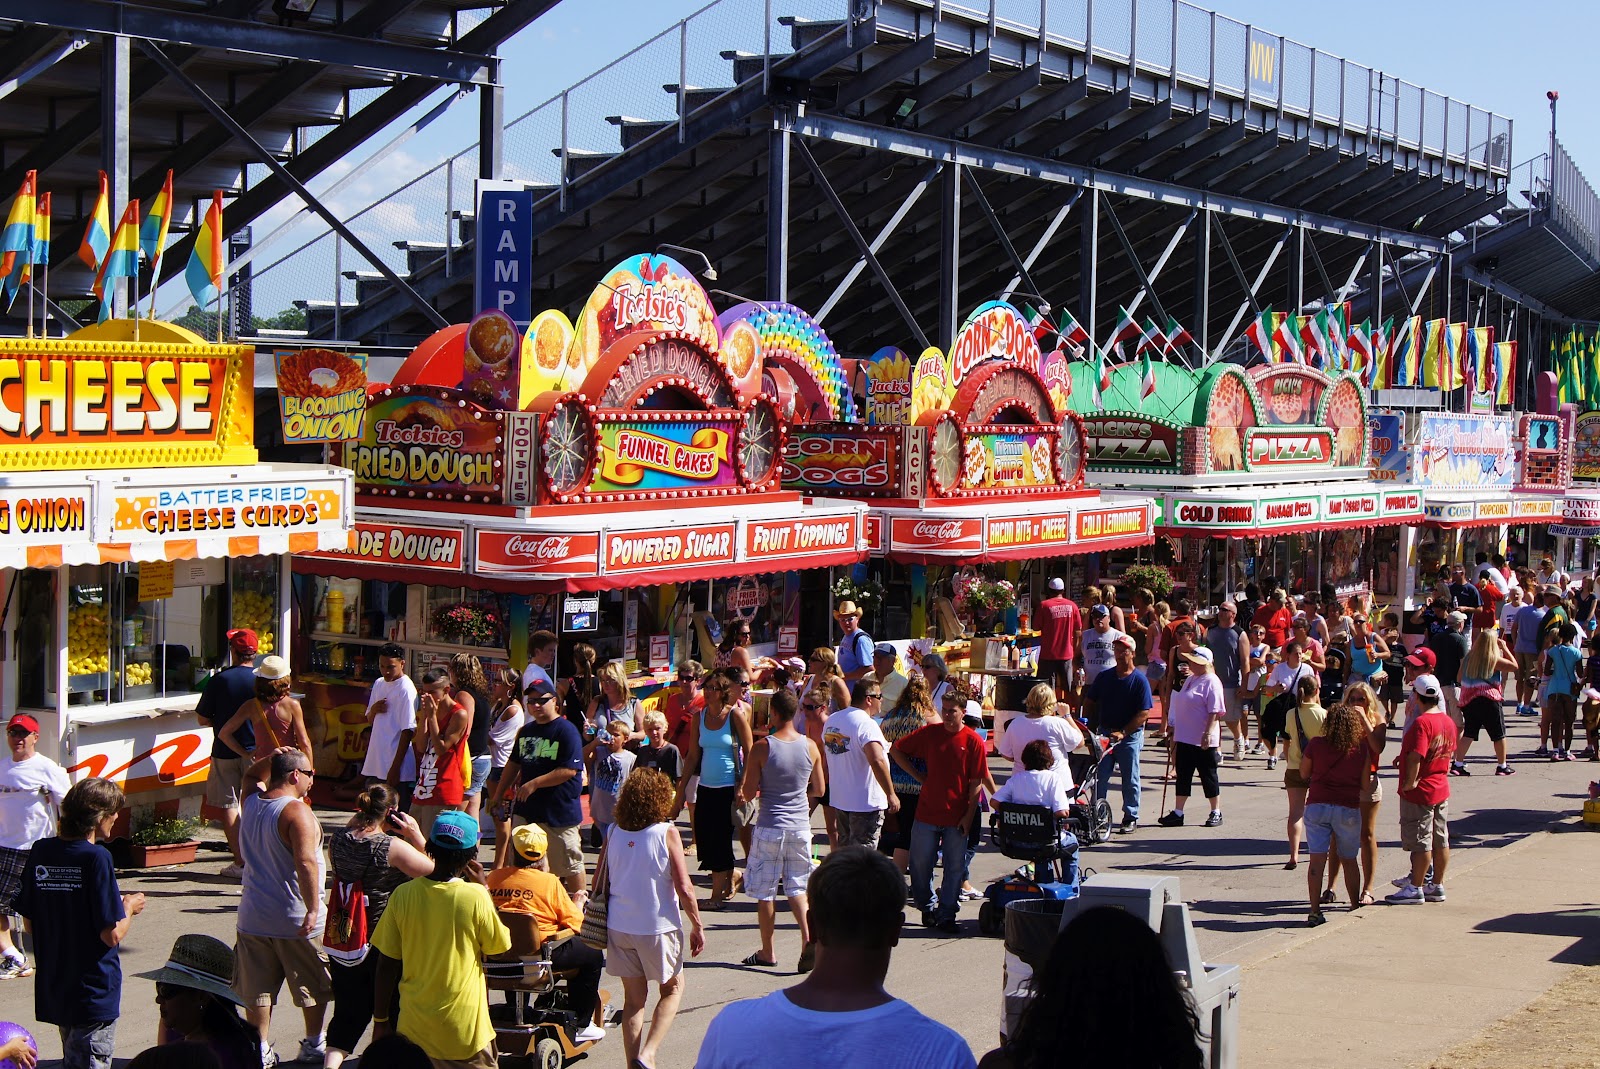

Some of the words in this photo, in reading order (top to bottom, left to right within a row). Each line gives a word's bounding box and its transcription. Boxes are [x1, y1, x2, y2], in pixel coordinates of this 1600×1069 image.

[494, 199, 519, 312] RAMP
[614, 284, 688, 330] Tootsie's
[952, 317, 992, 387] CORN
[1005, 310, 1041, 372] DOGS
[667, 341, 720, 399] DOUGH
[915, 355, 948, 389] Jack's
[1045, 357, 1071, 390] Jack's
[0, 358, 212, 437] CHEESE
[867, 377, 911, 395] Jack's
[284, 387, 366, 416] BLOOMING
[865, 400, 912, 426] FRIES
[285, 411, 365, 441] ONION
[375, 420, 463, 447] Tootsies
[1087, 421, 1152, 438] RICK'S
[1452, 422, 1482, 456] Sweet
[514, 417, 529, 501] TOOTSIE'S
[618, 432, 670, 466] FUNNEL
[674, 446, 715, 474] CAKES
[785, 439, 887, 464] CORN
[910, 429, 919, 496] JACK'S
[1038, 441, 1049, 460] HOT
[1087, 438, 1171, 462] IZZA
[1252, 437, 1323, 463] PIZZA
[346, 446, 408, 481] FRIED
[409, 450, 494, 485] DOUGH
[783, 463, 889, 486] DOGS
[968, 454, 985, 479] DOGS
[993, 457, 1024, 481] CHIPS
[159, 490, 243, 506] BATTER
[250, 487, 306, 502] FRIED
[1361, 497, 1374, 512] PIZZA
[1479, 503, 1509, 516] POPCORN
[1521, 503, 1537, 514] COTTON
[16, 497, 84, 533] ONION
[142, 506, 235, 534] CHEESE
[240, 503, 318, 527] CURDS
[1082, 516, 1101, 536] COLD
[1103, 510, 1141, 534] LEMONADE
[1180, 505, 1214, 523] COLD
[1217, 505, 1253, 523] DRINKS
[1266, 503, 1293, 519] SAUSAGE
[1294, 501, 1312, 517] PIZZA
[1448, 505, 1472, 518] CONES
[1562, 509, 1598, 518] CAKES
[753, 525, 792, 553] FRUIT
[794, 521, 848, 549] TOPPINGS
[913, 520, 964, 538] Coca-Cola
[990, 521, 1014, 545] BACON
[1015, 519, 1031, 543] BITS
[1033, 523, 1040, 536] or
[1041, 517, 1066, 540] CHEESE
[1549, 525, 1567, 535] FUNNEL
[1568, 527, 1581, 536] CAKE
[389, 529, 457, 563] DOUGH
[504, 535, 571, 557] Coca-Cola
[610, 535, 682, 565] POWERED
[685, 530, 730, 558] SUGAR
[565, 601, 581, 613] DEEP
[581, 601, 598, 613] FRIED
[738, 598, 758, 607] DOUGH
[1003, 811, 1044, 827] RENTAL
